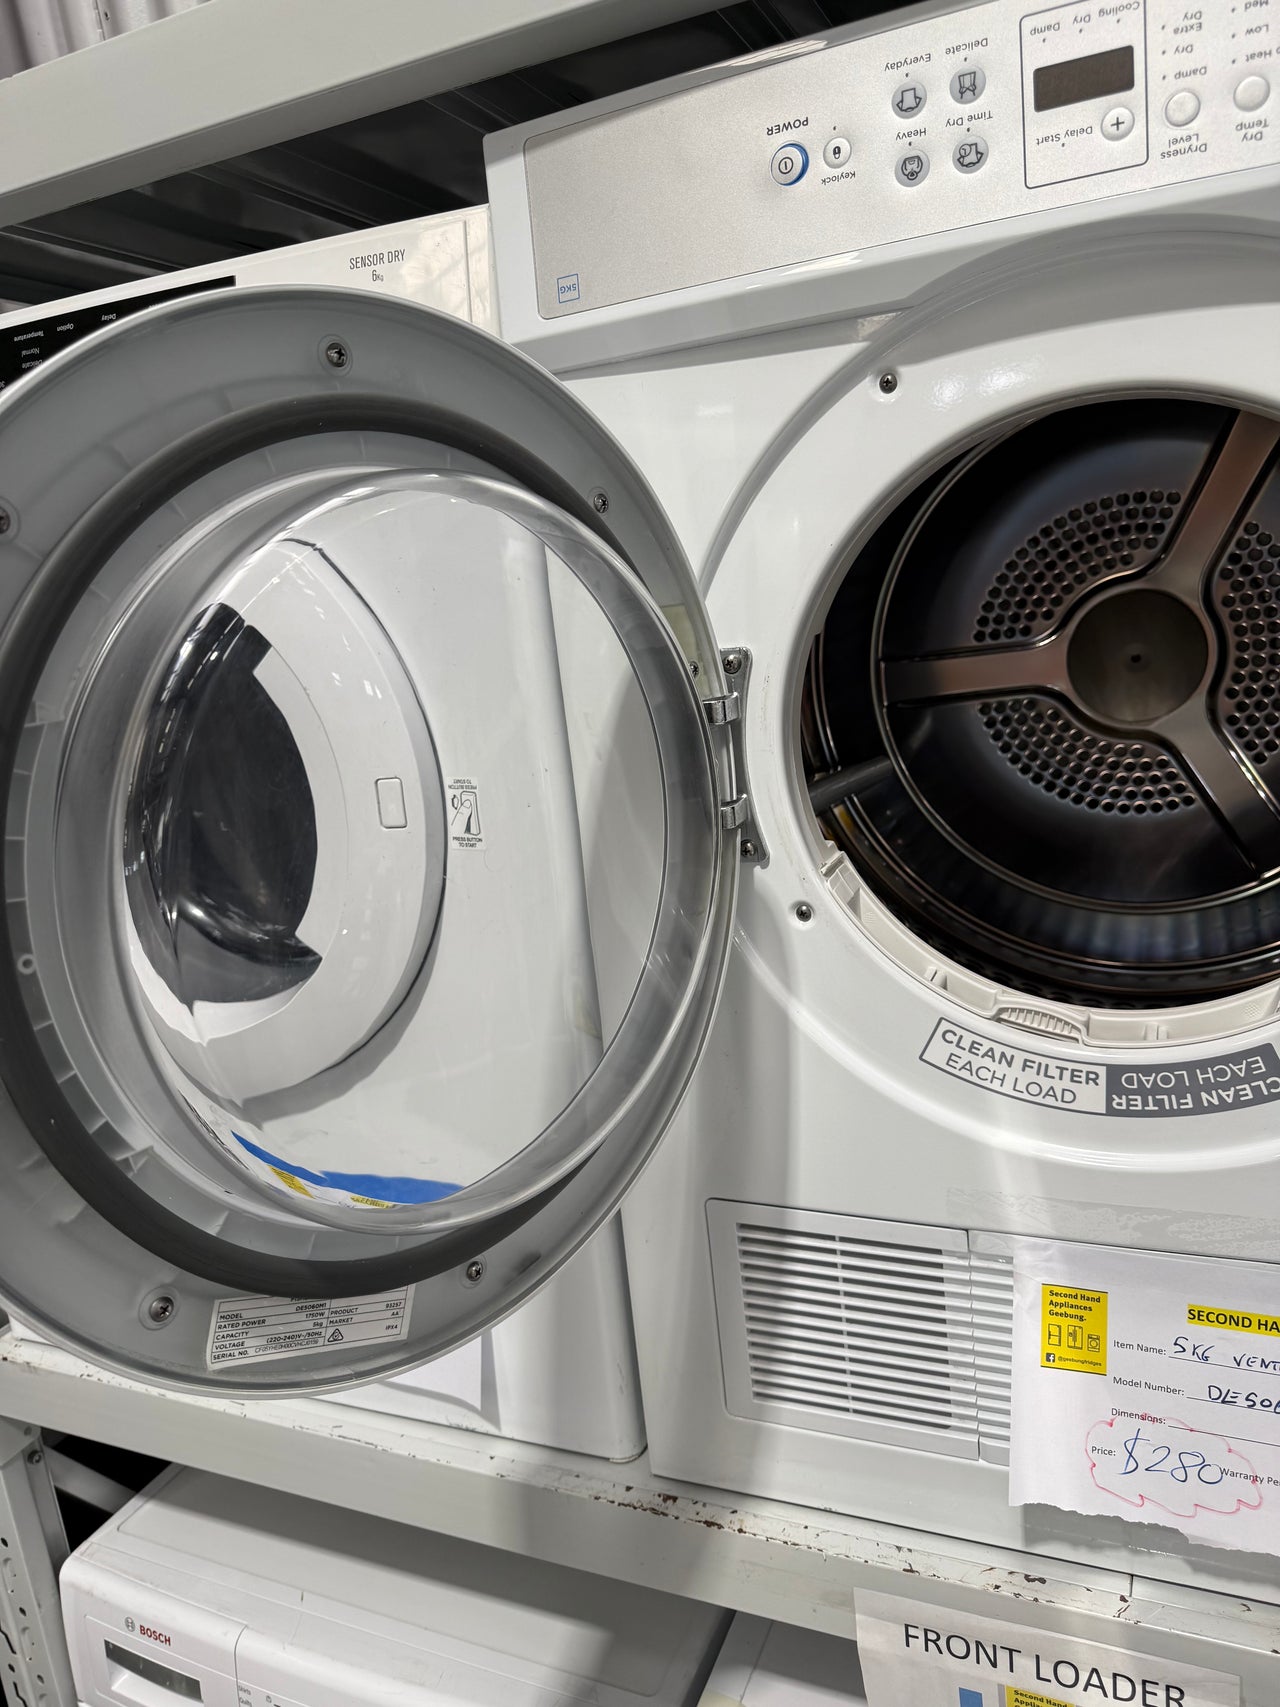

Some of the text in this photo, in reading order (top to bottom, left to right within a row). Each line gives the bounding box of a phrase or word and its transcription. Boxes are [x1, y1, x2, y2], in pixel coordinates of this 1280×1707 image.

[1098, 1, 1140, 18] Cooling
[1244, 0, 1269, 10] Med
[1073, 14, 1091, 25] Dry
[1183, 10, 1202, 22] Dry
[1029, 22, 1060, 36] Damp
[1173, 22, 1203, 35] Extra
[1244, 24, 1269, 35] Low
[945, 38, 988, 55] Delicate
[1174, 44, 1193, 55] Dry
[1244, 46, 1280, 62] o Heat
[884, 53, 931, 71] Everyday
[1174, 66, 1207, 80] Damp
[945, 110, 993, 128] Time Dry
[1235, 118, 1269, 131] Temp
[766, 117, 809, 136] POWER
[895, 128, 927, 140] Heavy
[1036, 126, 1093, 146] Delay Start
[1168, 133, 1199, 148] Level
[1241, 132, 1263, 143] Dry
[1161, 143, 1207, 159] Dryness
[821, 170, 856, 185] Keylock
[349, 249, 405, 270] SENSOR DRY
[560, 283, 576, 294] 5KG
[57, 323, 74, 331] Option
[14, 330, 44, 341] Temperature
[21, 348, 40, 357] Normal
[22, 359, 43, 368] Delicate
[941, 1029, 1100, 1086] CLEAN FILTER
[946, 1053, 1077, 1104] EACH LOAD
[1121, 1056, 1266, 1089] EACH LOAD
[1112, 1077, 1280, 1110] CLEAN FILTER
[1049, 1290, 1100, 1303] Second Hand
[1049, 1300, 1092, 1311] Appliances
[329, 1317, 353, 1325] MARKET
[1049, 1309, 1086, 1322] Geebung.
[1187, 1309, 1280, 1332] SECOND HA
[217, 1322, 240, 1330] RATED
[241, 1319, 266, 1327] POWER
[216, 1331, 249, 1340] CAPACITY
[215, 1341, 245, 1350] VOLTAGE
[213, 1352, 236, 1361] SERIAL
[1113, 1340, 1134, 1350] Item
[1137, 1344, 1166, 1355] Name:
[1233, 1353, 1280, 1371] VENT
[1113, 1377, 1142, 1388] Model
[1145, 1382, 1185, 1396] Number:
[1111, 1408, 1166, 1424] Dimensions:
[1092, 1428, 1280, 1486] Price: $280 Warranty Pe
[140, 1625, 171, 1646] BOSCH
[904, 1624, 1186, 1707] FRONT LOADER
[1014, 1690, 1043, 1702] Second
